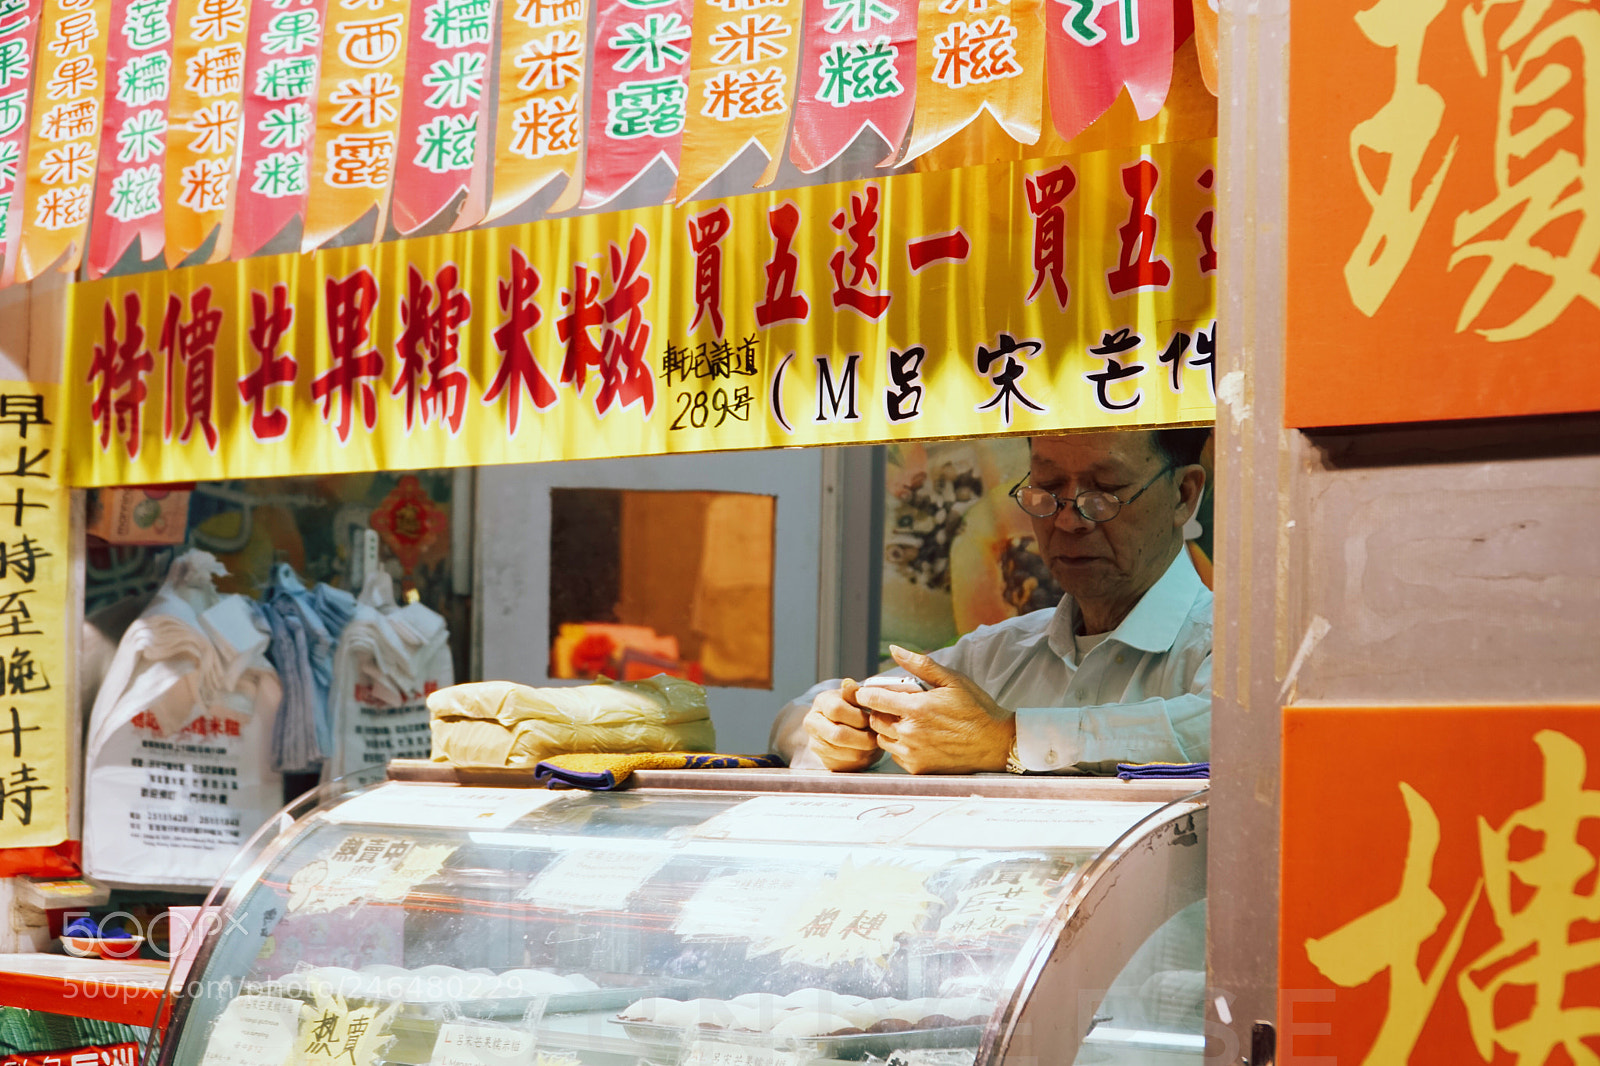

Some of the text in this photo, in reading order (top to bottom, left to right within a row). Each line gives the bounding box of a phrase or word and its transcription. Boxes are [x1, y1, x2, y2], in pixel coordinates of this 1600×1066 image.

[255, 0, 319, 194] 果糯米糍
[330, 0, 402, 187] 西米露
[611, 0, 690, 136] 米露
[707, 0, 790, 118] 米糍
[936, 0, 1018, 85] 糍
[687, 186, 970, 337] 買五送一
[1026, 159, 1217, 308] 買五
